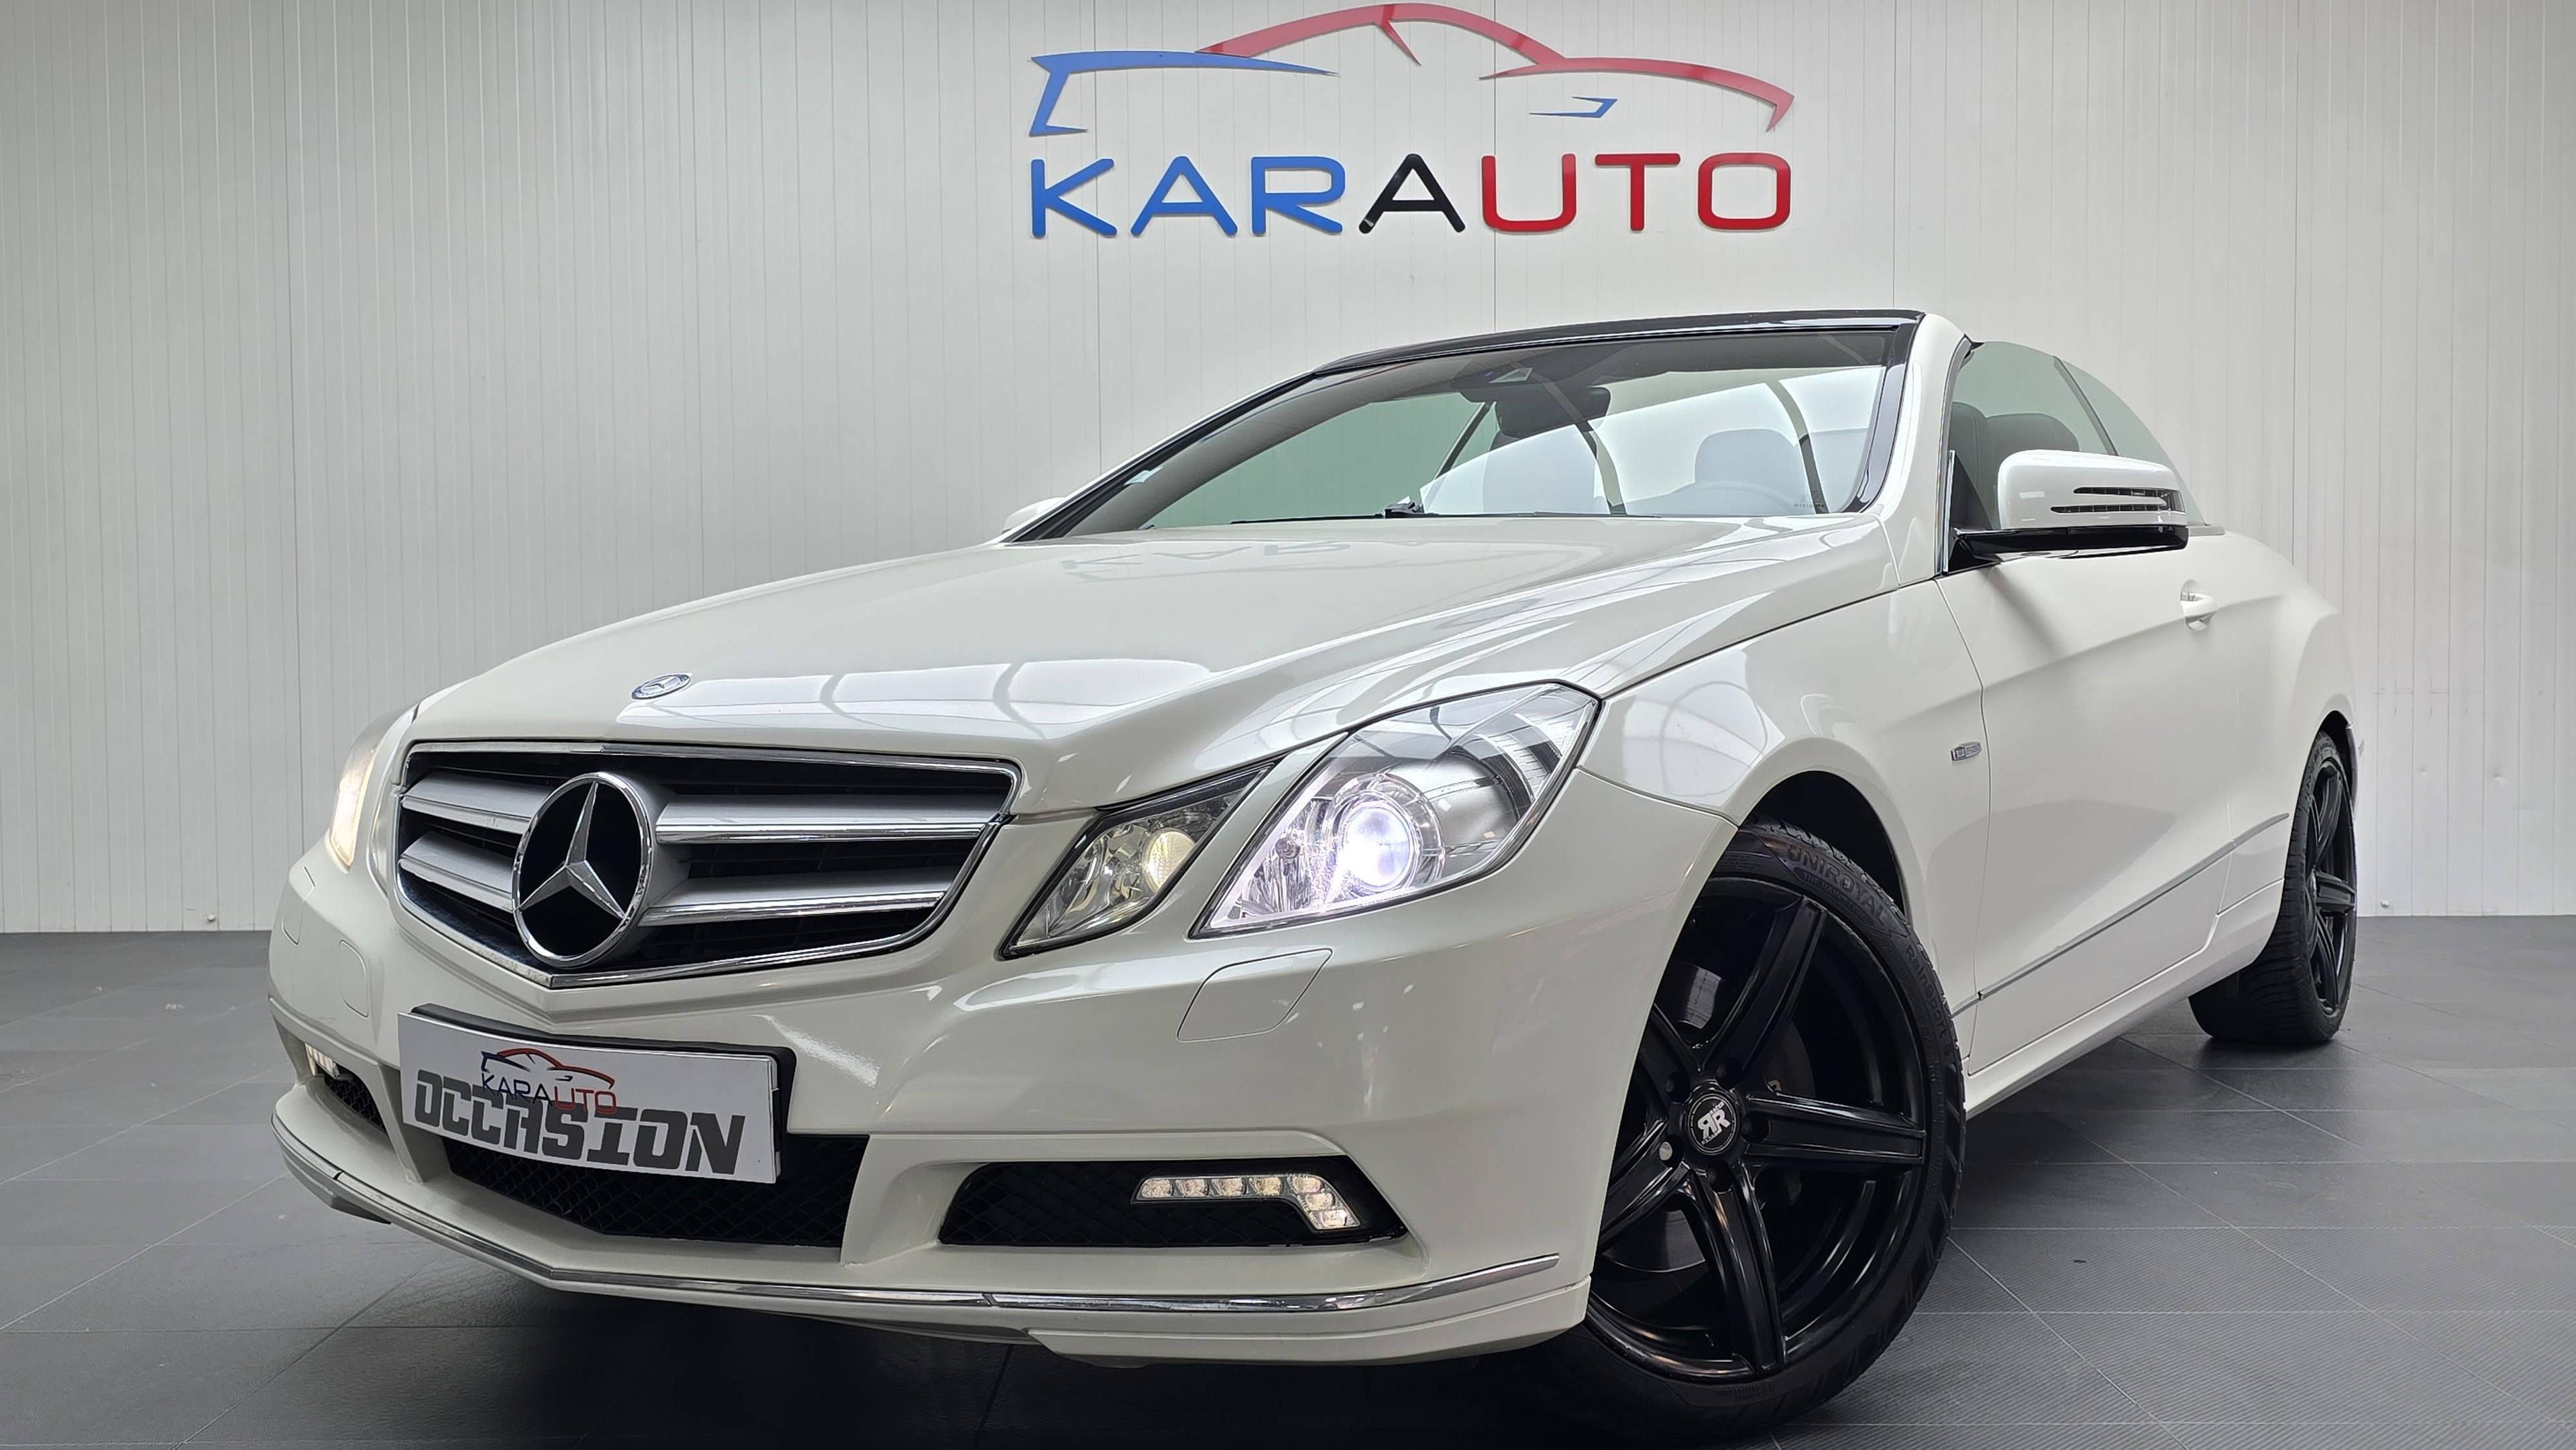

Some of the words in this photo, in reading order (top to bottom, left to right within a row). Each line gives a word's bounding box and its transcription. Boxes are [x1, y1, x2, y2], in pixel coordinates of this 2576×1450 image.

[1030, 152, 1792, 237] KARAUTO
[1787, 844, 1884, 926] UNIROYAL
[415, 1069, 745, 1175] OCCASION
[481, 1072, 617, 1115] KARAUTO
